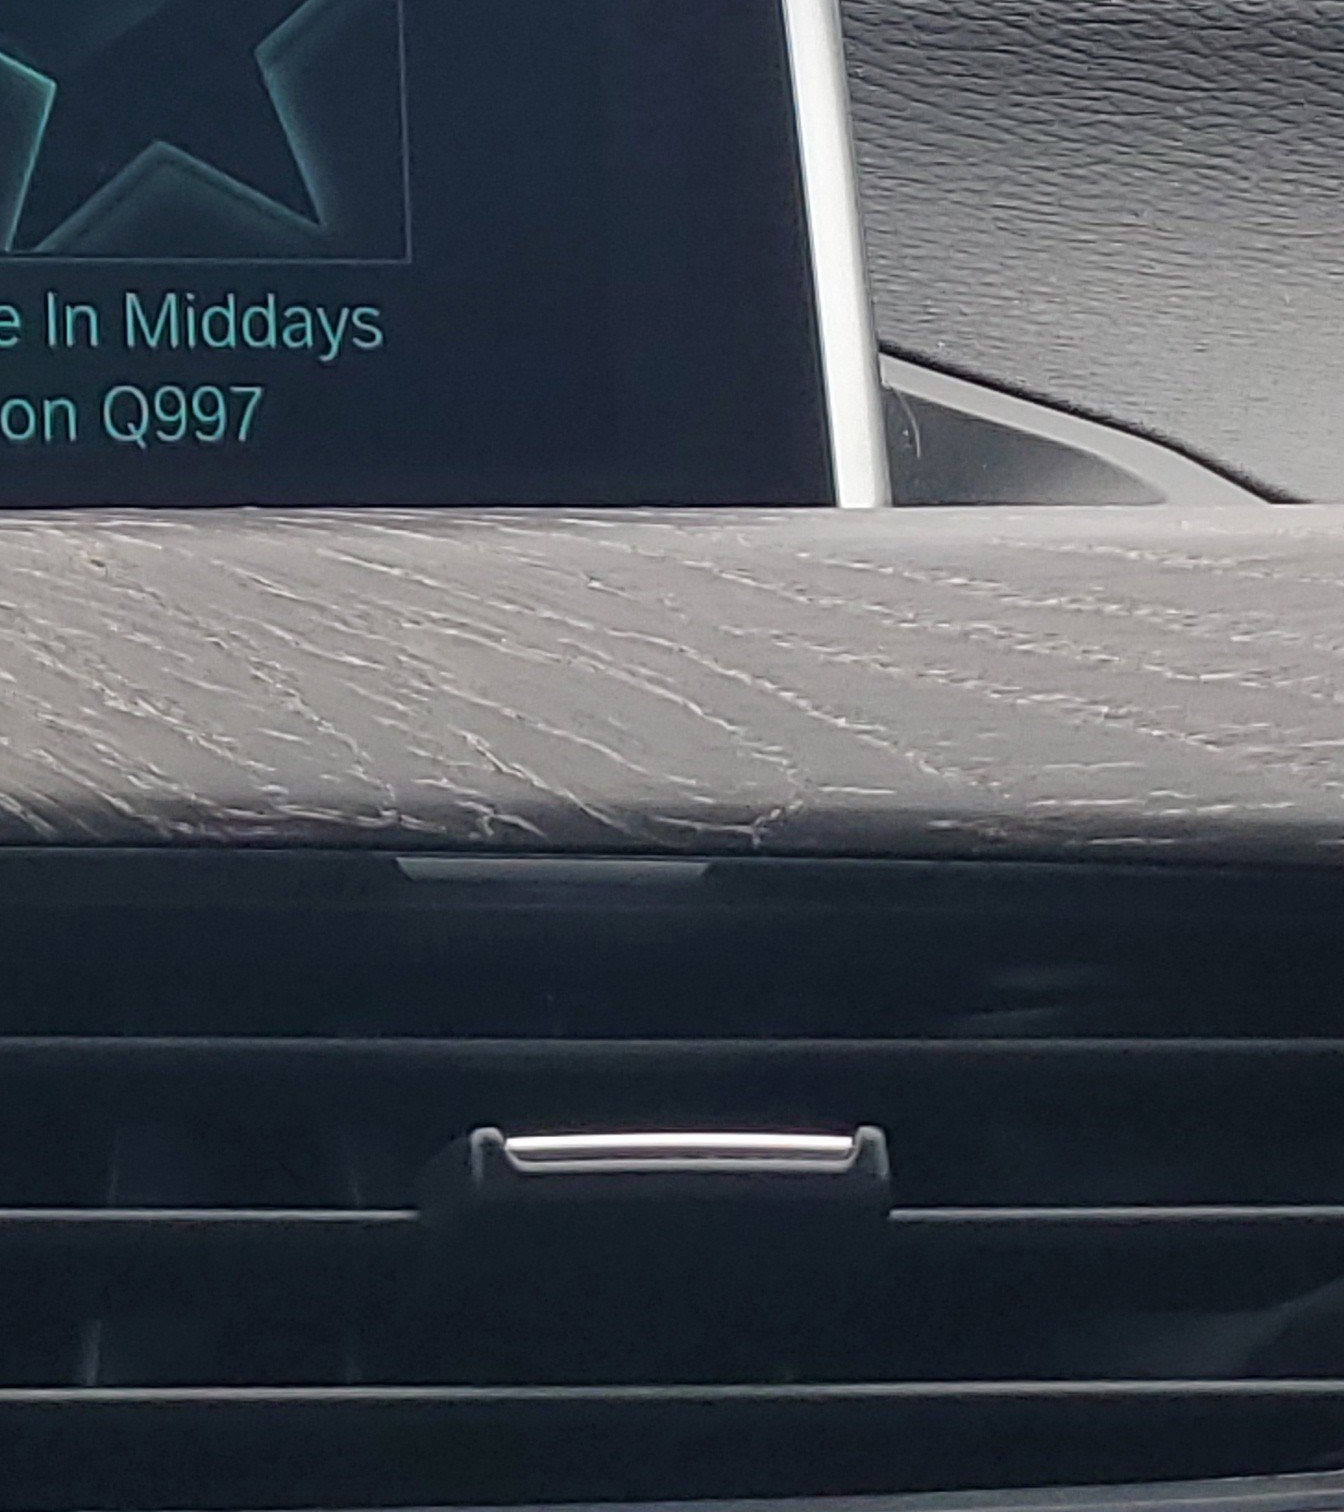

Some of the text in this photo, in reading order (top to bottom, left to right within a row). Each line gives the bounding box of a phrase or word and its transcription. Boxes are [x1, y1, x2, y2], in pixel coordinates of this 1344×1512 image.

[47, 291, 100, 348] In
[124, 292, 385, 362] Middays
[0, 385, 264, 449] on Q997
